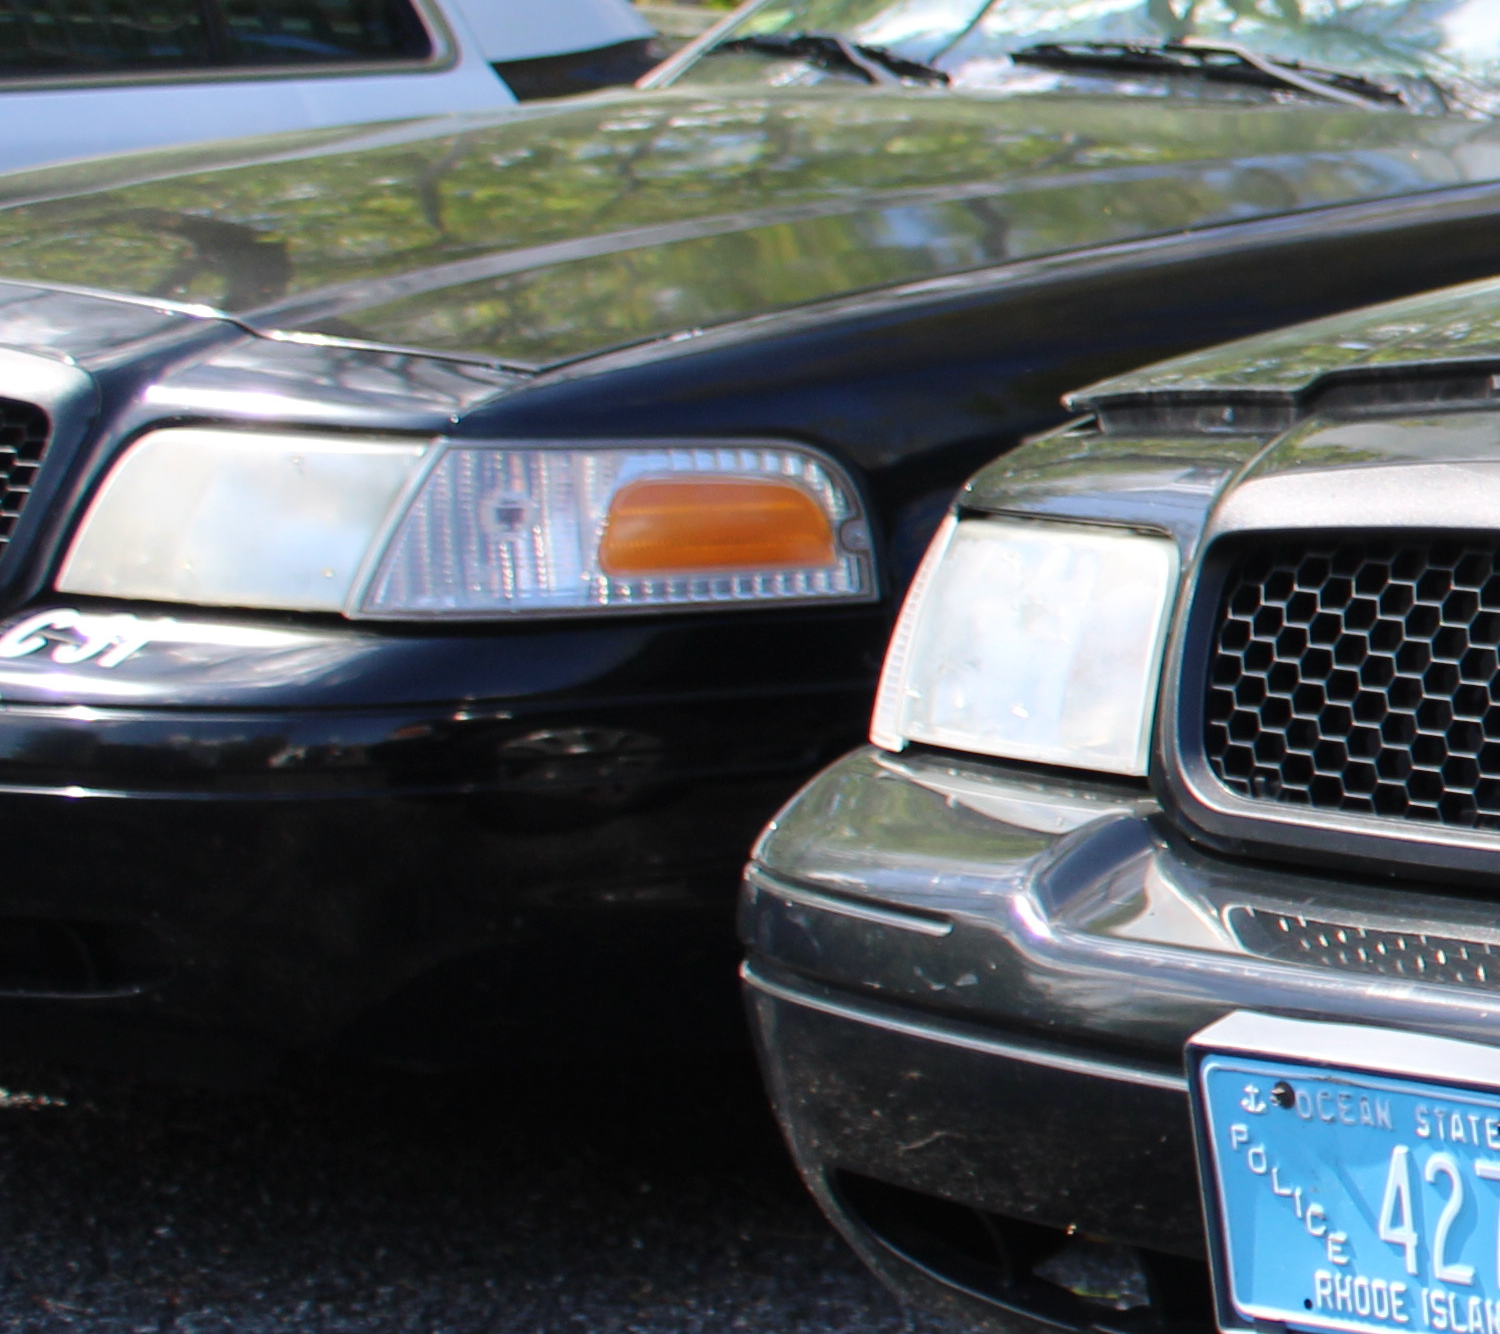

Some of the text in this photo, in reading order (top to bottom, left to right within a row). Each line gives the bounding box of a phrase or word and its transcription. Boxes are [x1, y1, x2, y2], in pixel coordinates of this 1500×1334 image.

[1296, 1087, 1394, 1131] OCEAN
[1229, 1123, 1350, 1265] POLICE
[1313, 1269, 1410, 1324] RHODE
